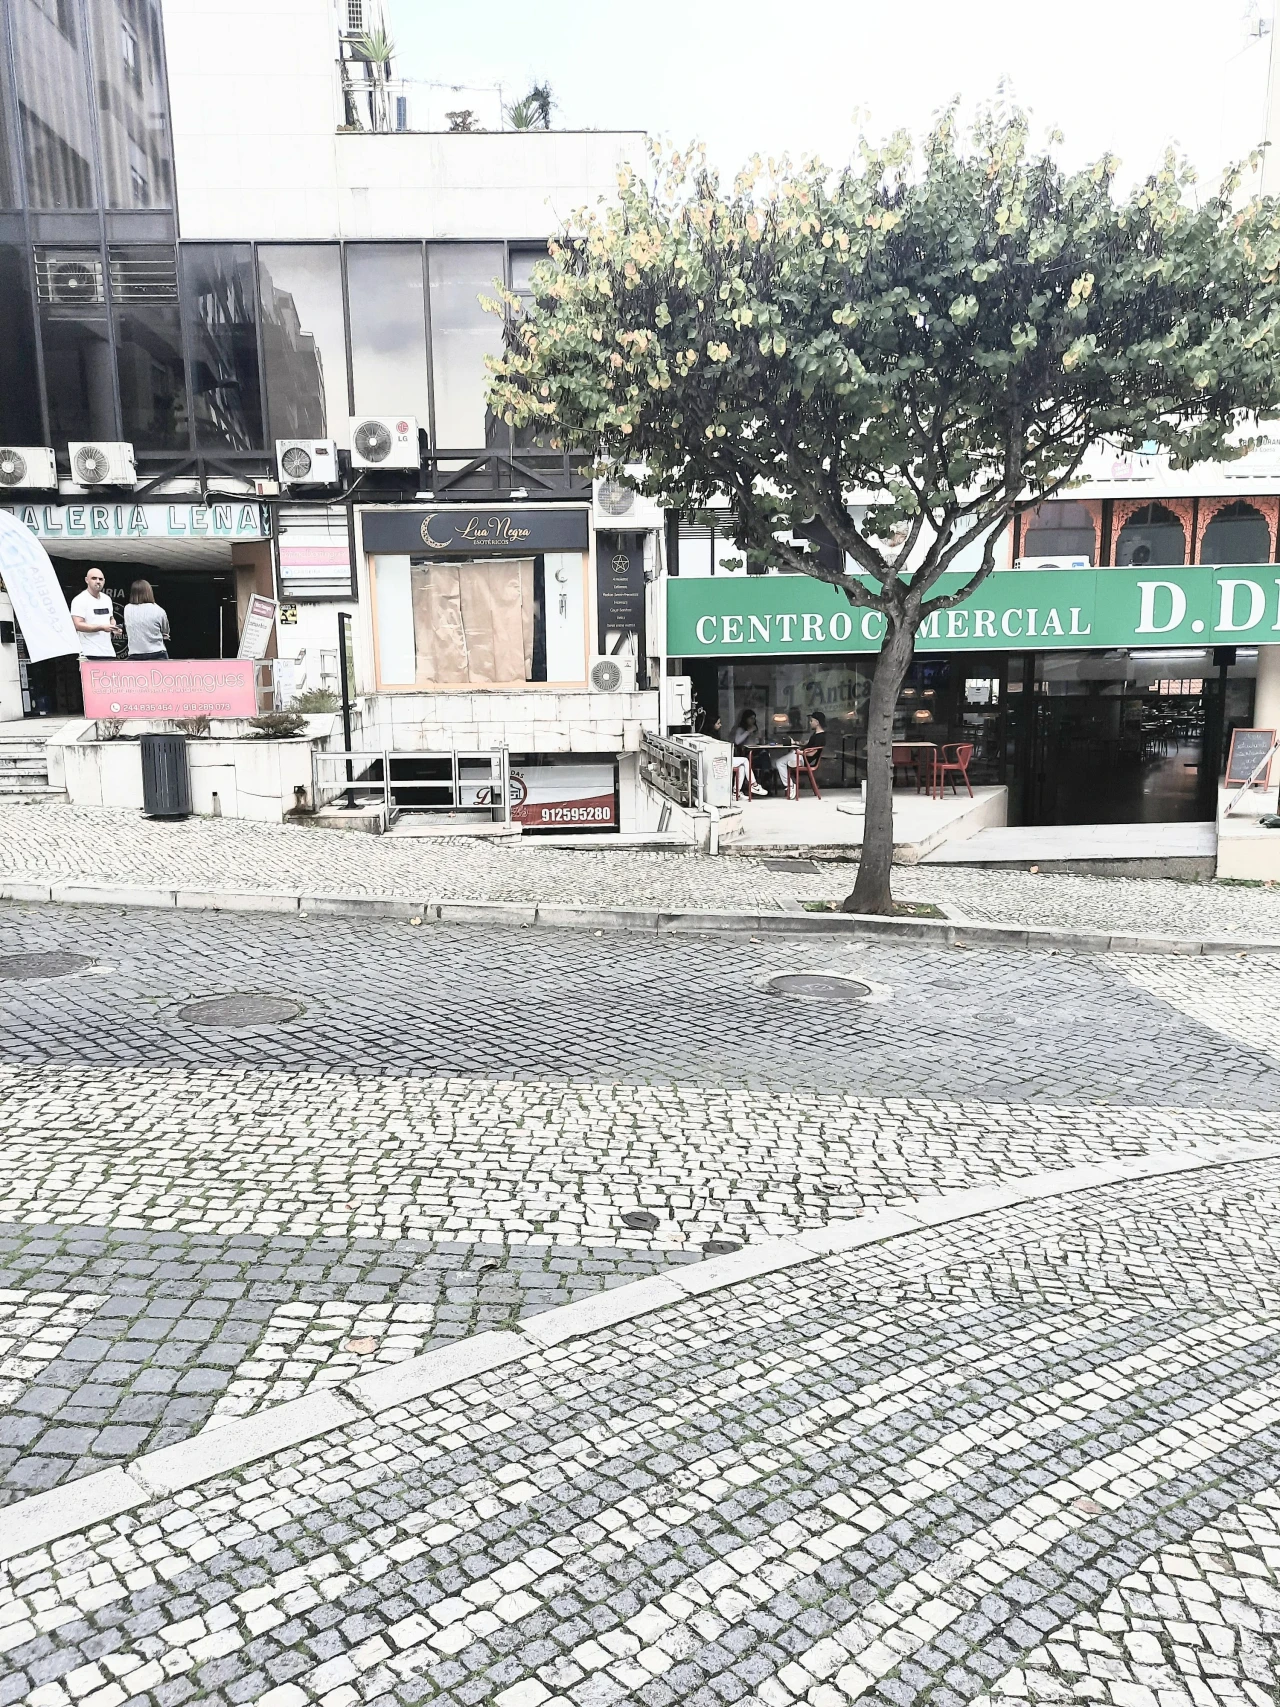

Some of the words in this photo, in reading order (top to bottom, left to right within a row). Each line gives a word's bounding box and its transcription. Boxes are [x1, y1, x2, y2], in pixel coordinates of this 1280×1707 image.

[2, 505, 149, 533] ALERIA
[168, 505, 258, 535] LENA
[455, 516, 488, 540] Lua
[487, 516, 531, 541] Negra
[695, 612, 852, 644] CENTRO
[860, 607, 1091, 641] CMERCIAL
[90, 669, 149, 688] Fátima
[150, 668, 246, 693] Domingues
[541, 806, 610, 822] 912595280
